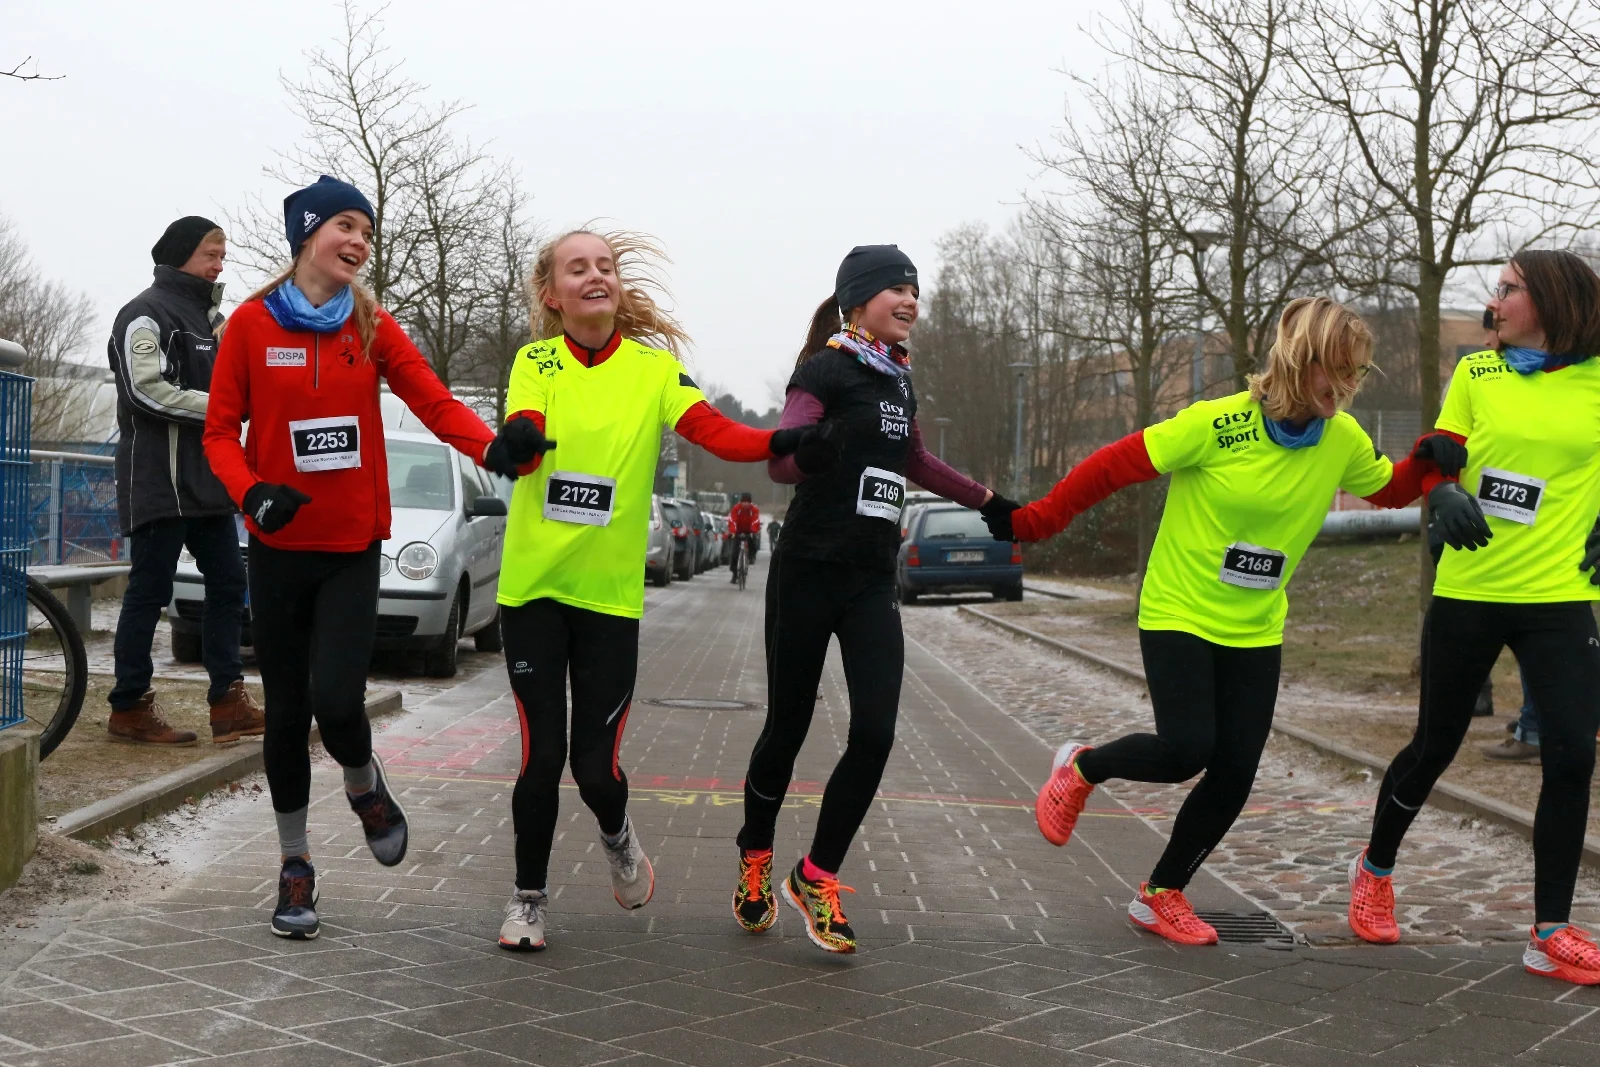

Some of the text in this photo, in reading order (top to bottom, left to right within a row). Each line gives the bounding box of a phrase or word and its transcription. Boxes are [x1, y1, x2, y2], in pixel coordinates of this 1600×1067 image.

[1469, 363, 1513, 380] Sport
[879, 400, 904, 416] City
[880, 418, 909, 438] Sport
[1212, 410, 1253, 430] City
[306, 431, 349, 451] 2253
[1217, 427, 1260, 449] Sport
[559, 484, 601, 505] 2172
[873, 482, 899, 502] 2169
[1489, 482, 1529, 503] 2173
[1235, 554, 1274, 572] 2168
